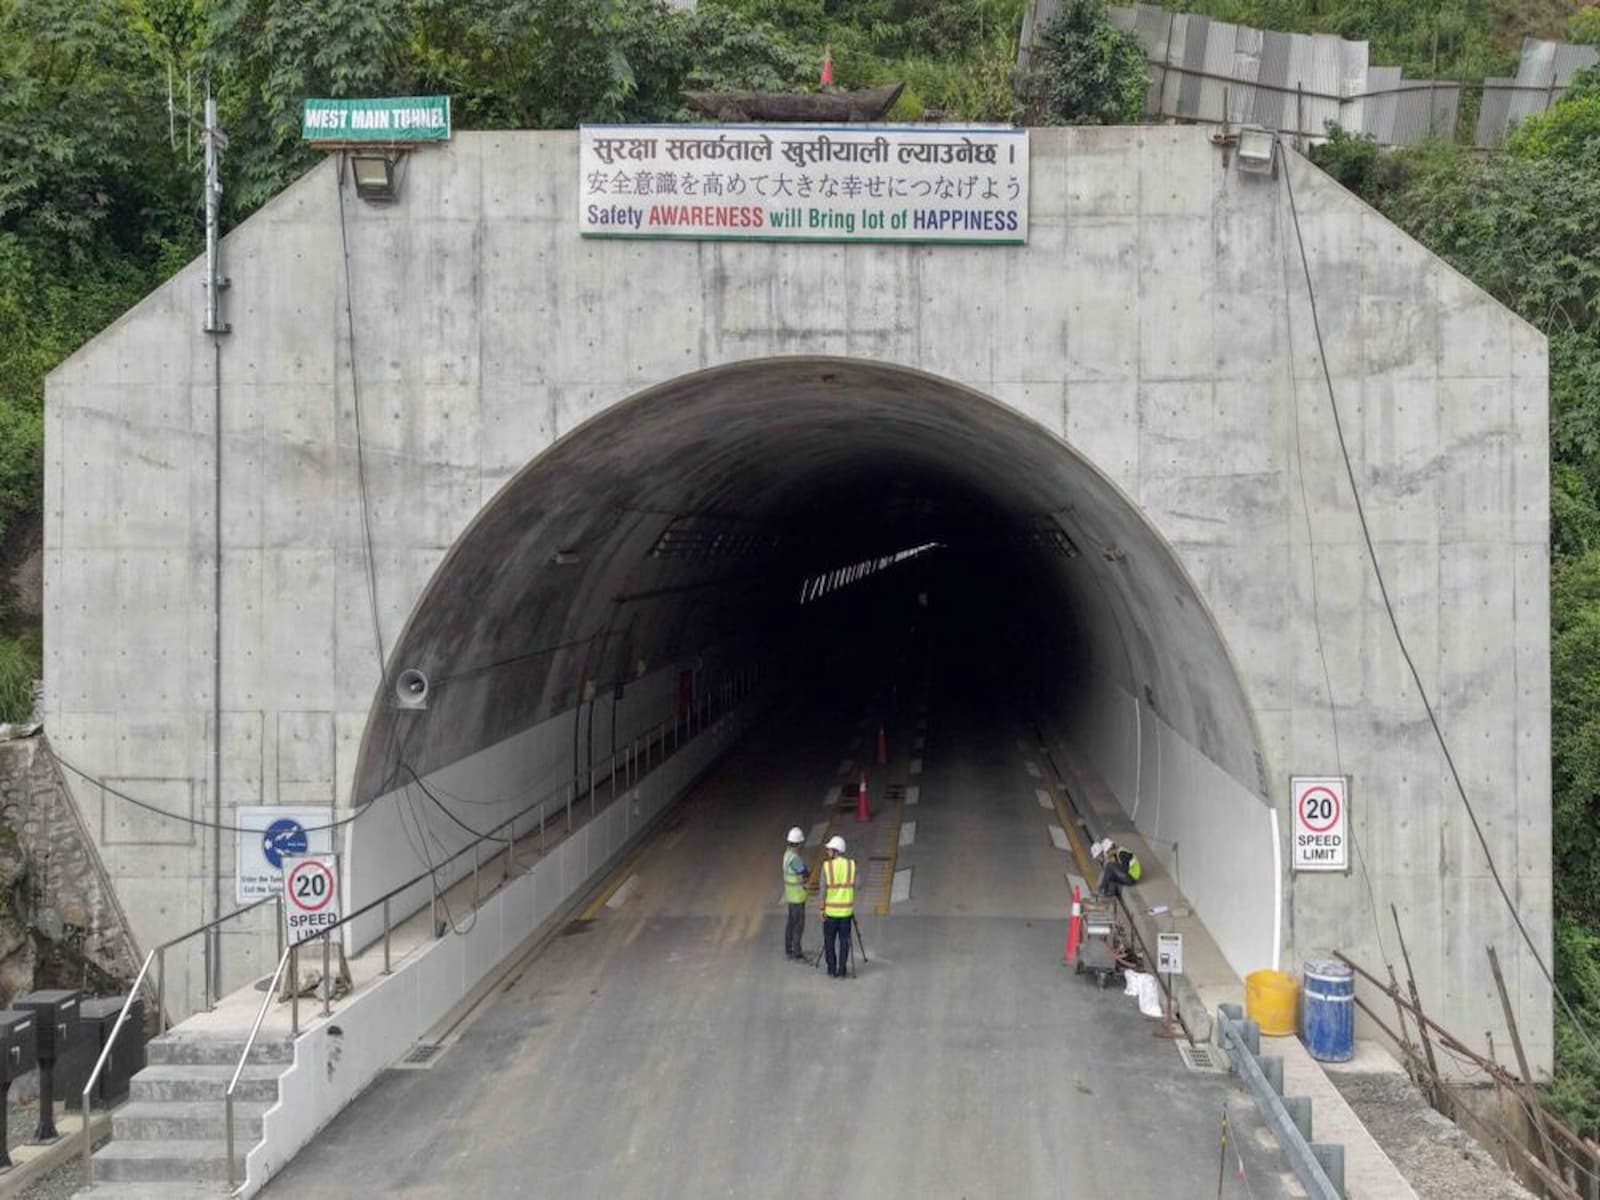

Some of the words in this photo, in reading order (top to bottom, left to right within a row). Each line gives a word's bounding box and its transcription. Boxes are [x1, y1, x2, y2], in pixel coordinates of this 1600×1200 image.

[306, 109, 348, 128] WEST
[351, 109, 389, 129] MAIN
[391, 107, 445, 129] TUNNEL
[593, 138, 658, 164] सुरक्षा
[665, 134, 773, 161] सतर्कताले
[781, 134, 889, 168] खुसीयाली
[897, 137, 998, 164] ल्याउनेछ
[587, 169, 1020, 199] 安全意識を高めて大きな幸せにつなげよう
[588, 204, 643, 229] Safety
[649, 205, 764, 228] AWARENESS
[770, 207, 802, 228] will
[809, 208, 855, 233] Bring
[862, 209, 884, 229] lot
[891, 208, 907, 229] of
[914, 209, 1018, 231] HAPPINESS
[1306, 798, 1332, 819] 20
[1298, 834, 1341, 846] SPEED
[1303, 849, 1336, 860] LIMIT
[297, 874, 325, 897] 20
[290, 913, 337, 927] SPEED
